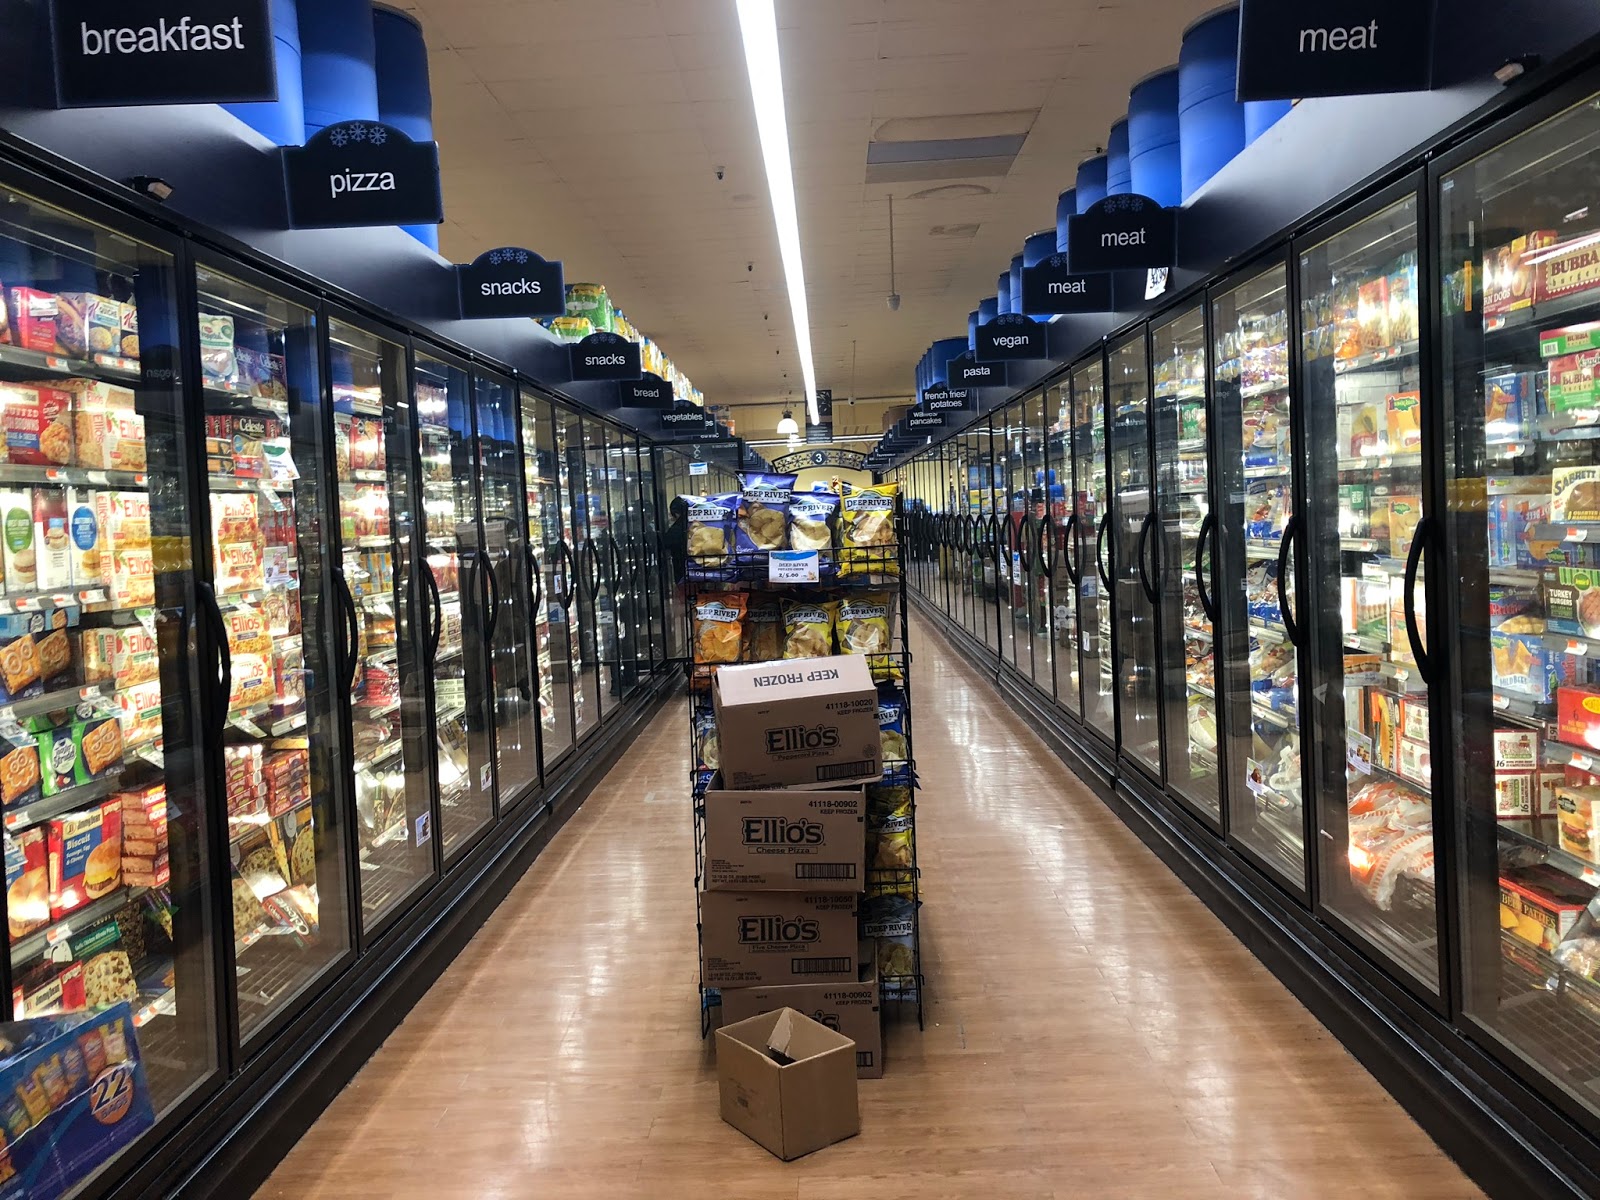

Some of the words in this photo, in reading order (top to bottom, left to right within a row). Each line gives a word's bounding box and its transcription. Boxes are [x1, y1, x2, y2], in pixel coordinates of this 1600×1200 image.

[81, 17, 246, 56] breakfast
[1299, 20, 1379, 53] meat
[329, 169, 396, 199] pizza
[1100, 227, 1146, 248] meat
[1551, 249, 1600, 276] BUBBA
[480, 278, 541, 296] snacks
[1047, 278, 1087, 296] meat
[992, 335, 1029, 348] vegan
[585, 353, 626, 366] snacks
[963, 366, 991, 379] pasta
[633, 388, 660, 398] bread
[924, 391, 948, 401] french
[949, 389, 967, 400] fries/
[930, 401, 963, 411] potatoes
[662, 412, 703, 423] vegetables
[910, 416, 943, 426] pancakes
[239, 418, 265, 433] Celeste
[815, 453, 823, 463] 3
[1554, 470, 1596, 497] SABRETT
[743, 490, 763, 500] DEEP
[764, 490, 790, 500] RIVER
[808, 502, 833, 513] RIVER
[847, 499, 867, 508] DEEP
[868, 498, 893, 507] RIVER
[688, 509, 703, 517] EEP
[1549, 588, 1573, 599] TURKEY
[1549, 597, 1573, 606] BURGERS
[714, 611, 737, 619] RIVER
[787, 613, 803, 621] DEEP
[804, 612, 828, 620] RIVER
[841, 609, 860, 618] DEEP
[861, 606, 885, 615] RIVER
[753, 673, 803, 688] FROZEN
[807, 669, 839, 682] KEEP
[826, 700, 873, 711] 41118-10020
[852, 706, 874, 714] FROZEN
[767, 727, 838, 751] Ellio's
[1521, 804, 1529, 813] 16
[744, 819, 822, 844] Ellio's
[66, 833, 91, 850] Biscuit
[1523, 904, 1556, 929] PATTIES
[740, 916, 817, 942] Ellio's
[867, 924, 888, 935] DEEP
[888, 922, 912, 933] RIVER
[824, 992, 872, 1000] 41118-00902
[92, 1068, 128, 1112] 22
